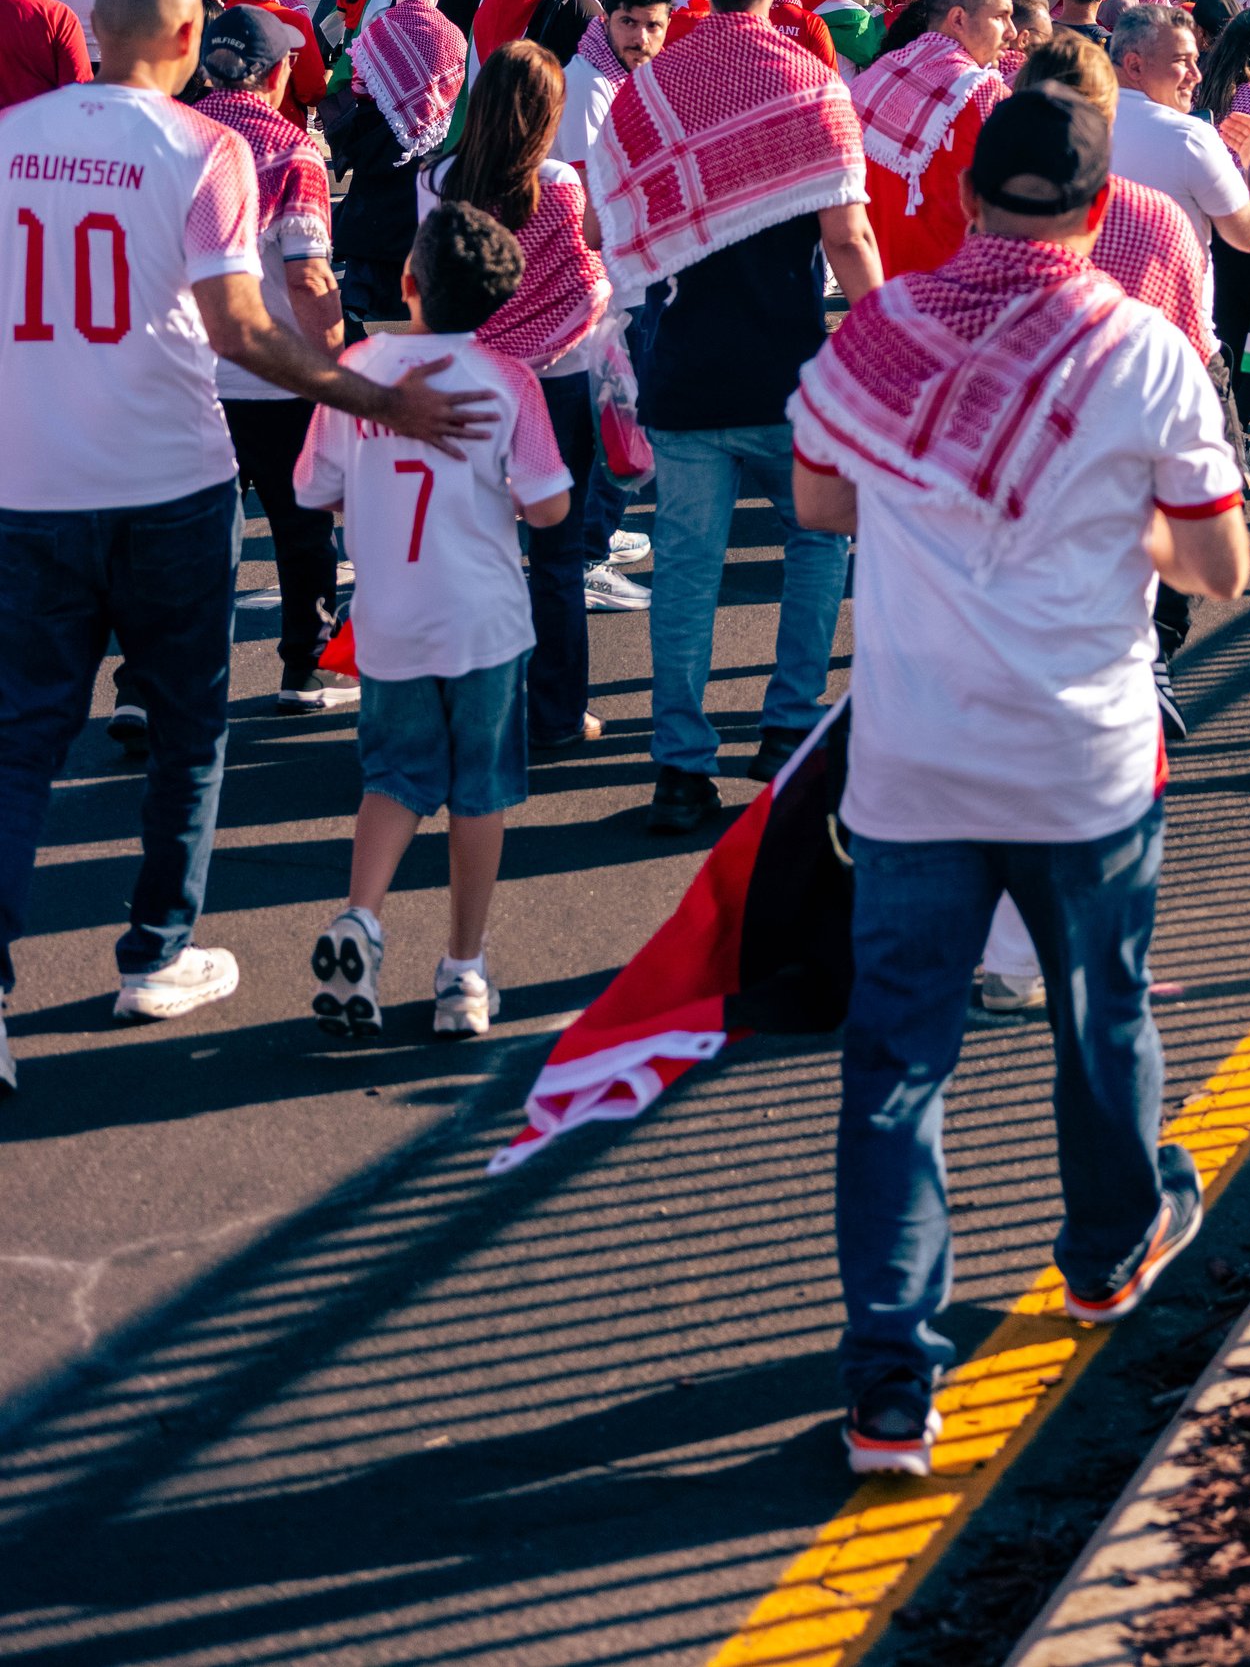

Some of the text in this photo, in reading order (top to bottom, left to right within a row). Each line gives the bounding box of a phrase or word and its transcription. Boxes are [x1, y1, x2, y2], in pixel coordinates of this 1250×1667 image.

[211, 36, 246, 50] HILFIGER
[776, 25, 800, 37] ANI
[9, 154, 144, 190] ABUHSSEIN
[14, 207, 131, 344] 10
[394, 459, 434, 563] 7
